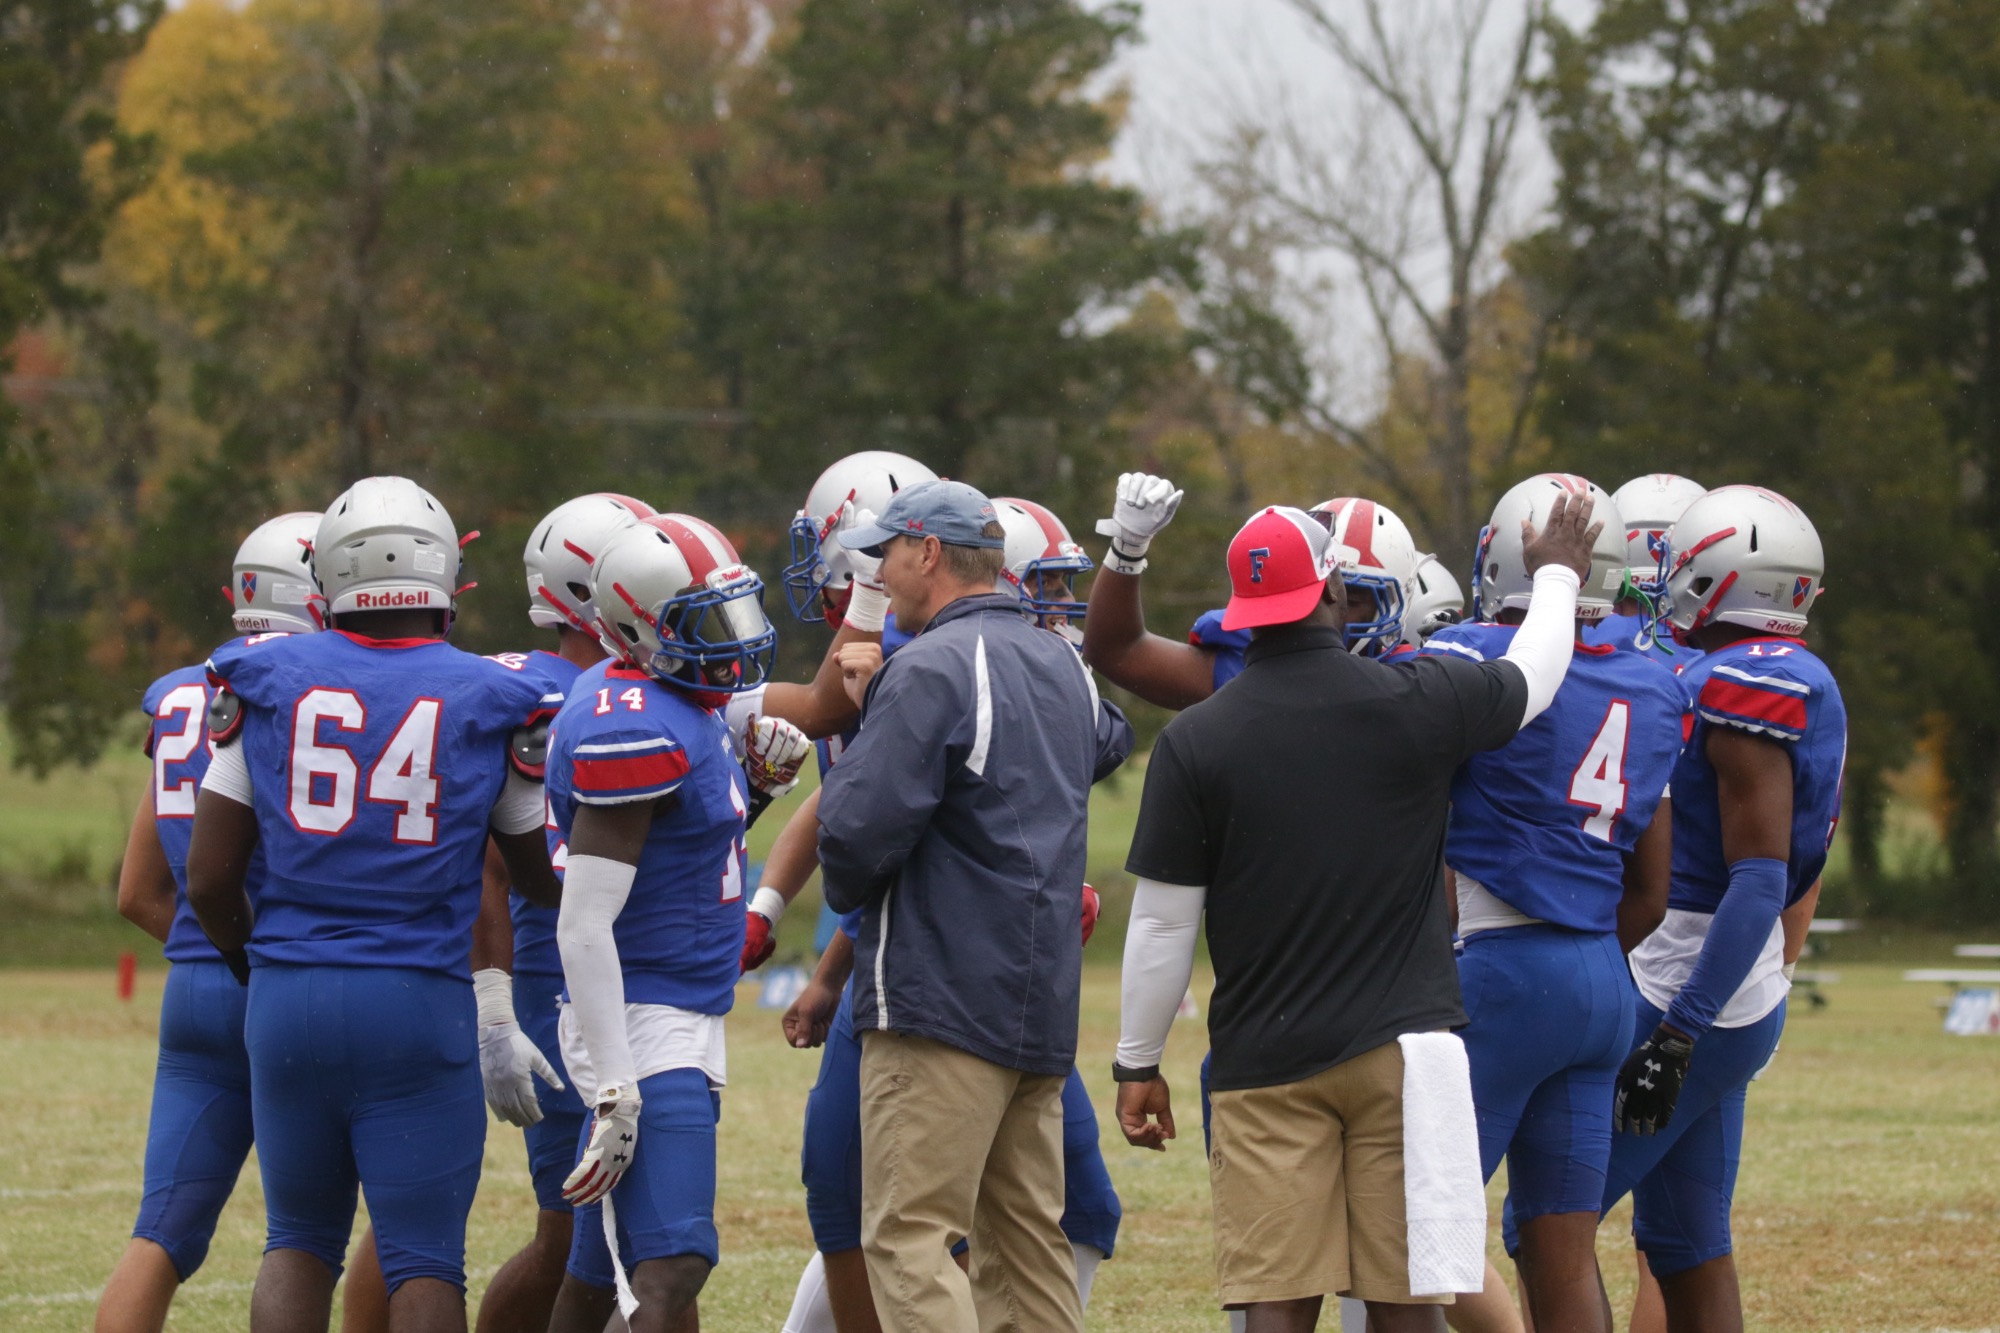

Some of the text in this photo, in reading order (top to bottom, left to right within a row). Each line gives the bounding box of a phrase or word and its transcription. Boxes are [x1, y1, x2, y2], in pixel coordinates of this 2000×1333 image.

[1248, 547, 1270, 583] F
[356, 591, 429, 608] Riddell
[1575, 606, 1601, 617] dell
[1766, 620, 1801, 633] Ridde
[1746, 644, 1796, 656] 17
[595, 687, 645, 716] 14
[153, 683, 214, 819] 2
[288, 685, 444, 846] 64
[1567, 698, 1631, 843] 4
